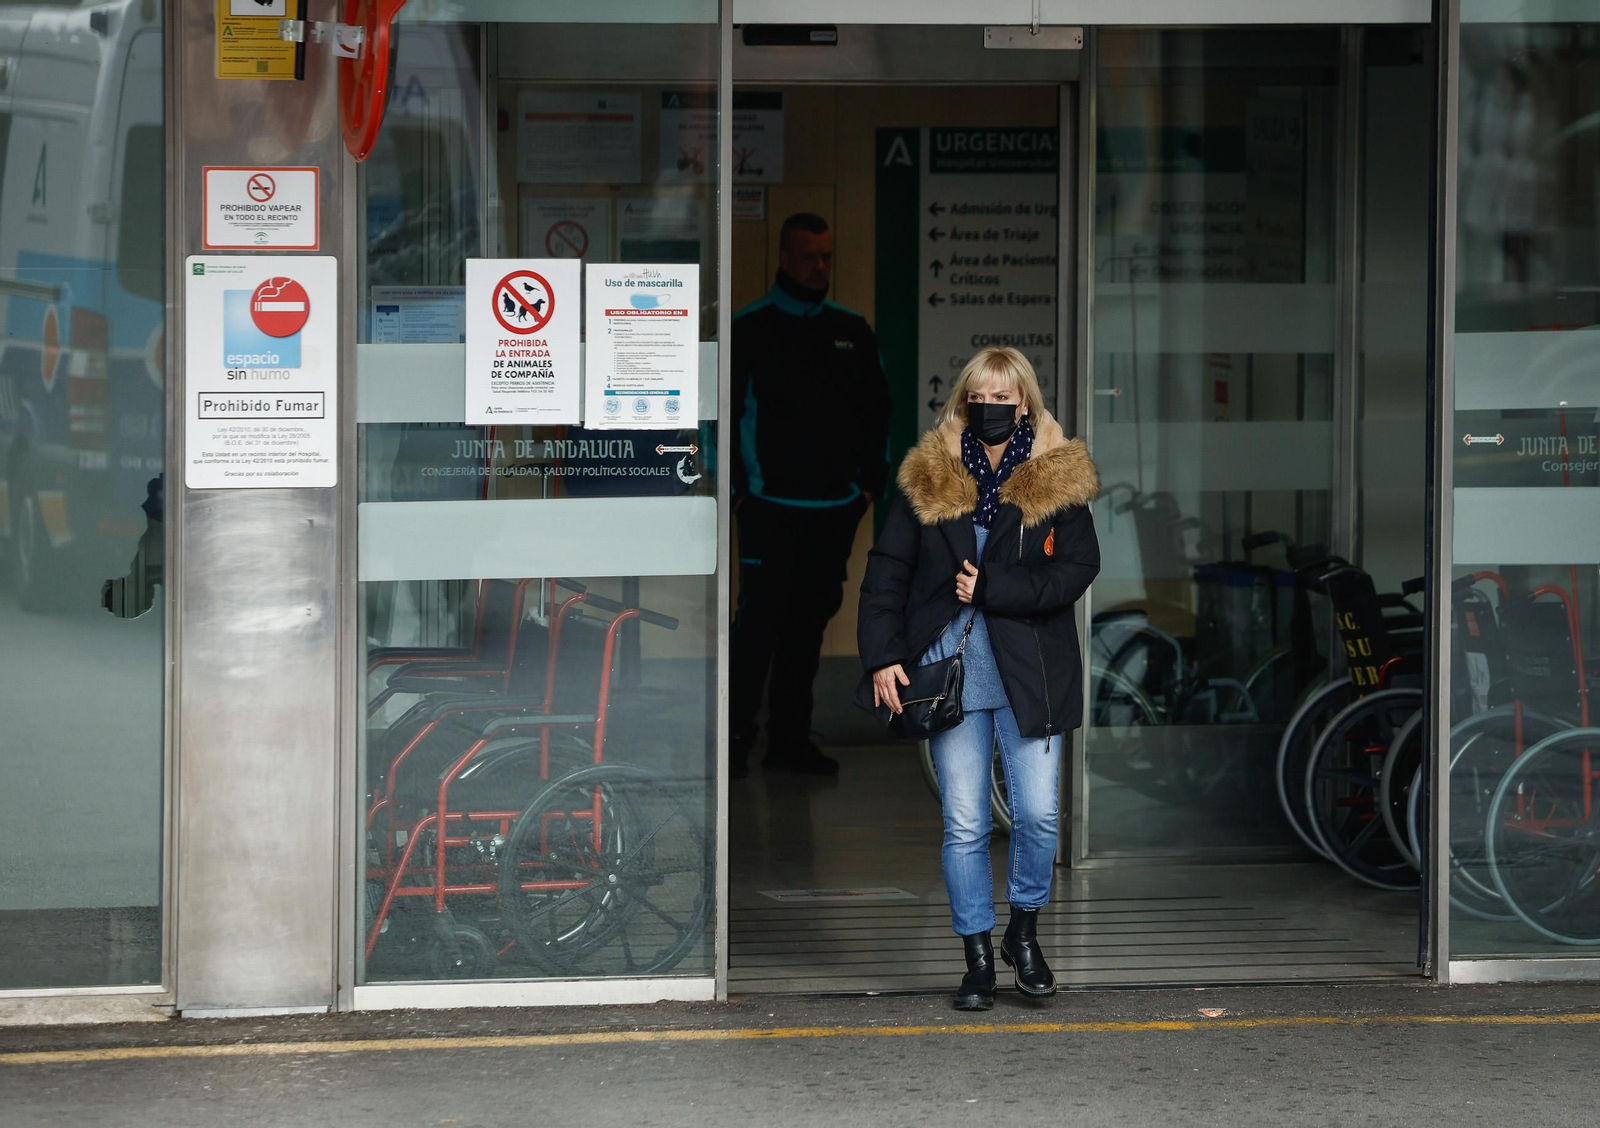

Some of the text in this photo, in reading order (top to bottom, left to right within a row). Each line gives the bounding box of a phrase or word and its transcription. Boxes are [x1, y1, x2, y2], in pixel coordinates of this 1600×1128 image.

[220, 204, 302, 212] PROHIBIDO VAPEAR
[1015, 202, 1031, 216] de
[983, 228, 999, 241] de
[1003, 228, 1040, 243] Triaje
[983, 252, 999, 266] de
[605, 279, 683, 288] Uso de mascarilla
[950, 271, 1000, 285] Críticos
[950, 292, 1051, 307] Salas de Espera
[498, 339, 548, 347] PROHIBIDA
[971, 333, 1054, 348] CONSULTAS
[227, 351, 279, 368] espacio
[496, 350, 551, 358] LA ENTRADA
[494, 360, 552, 368] DE ANIMALES
[227, 367, 290, 380] sin humo
[491, 368, 555, 378] DE COMPAÑÍA
[204, 400, 320, 412] Prohibido Fumar
[452, 440, 634, 459] JUNTA DE ANDALUCIA
[1516, 436, 1597, 456] JUNTA DE
[422, 465, 476, 476] CONSEJERÍA
[478, 467, 490, 476] DE
[492, 466, 542, 478] IGUALDAD,
[583, 464, 627, 476] POLÍTICAS
[628, 466, 670, 476] SOCIALES
[1542, 460, 1599, 474] Consejer
